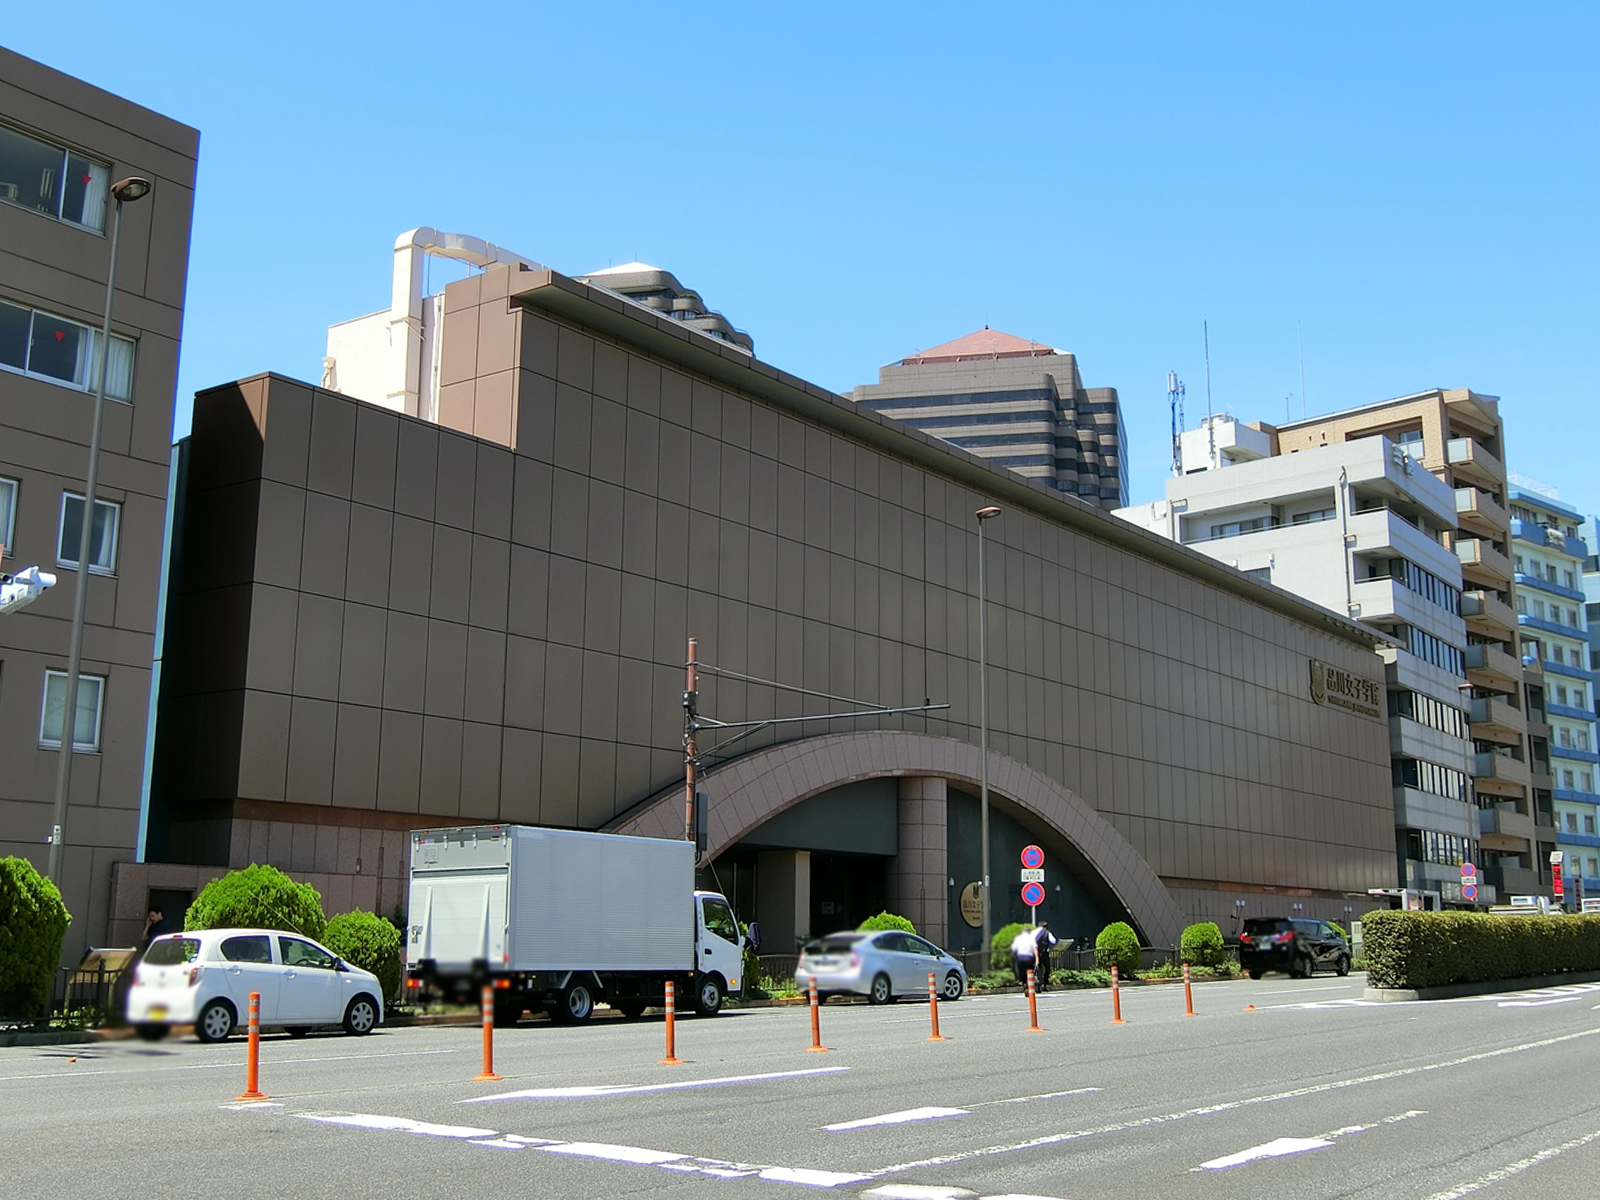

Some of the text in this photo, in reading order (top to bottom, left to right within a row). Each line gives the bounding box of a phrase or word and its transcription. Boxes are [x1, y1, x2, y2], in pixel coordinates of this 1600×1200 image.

[1326, 668, 1379, 706] 品川女子学院
